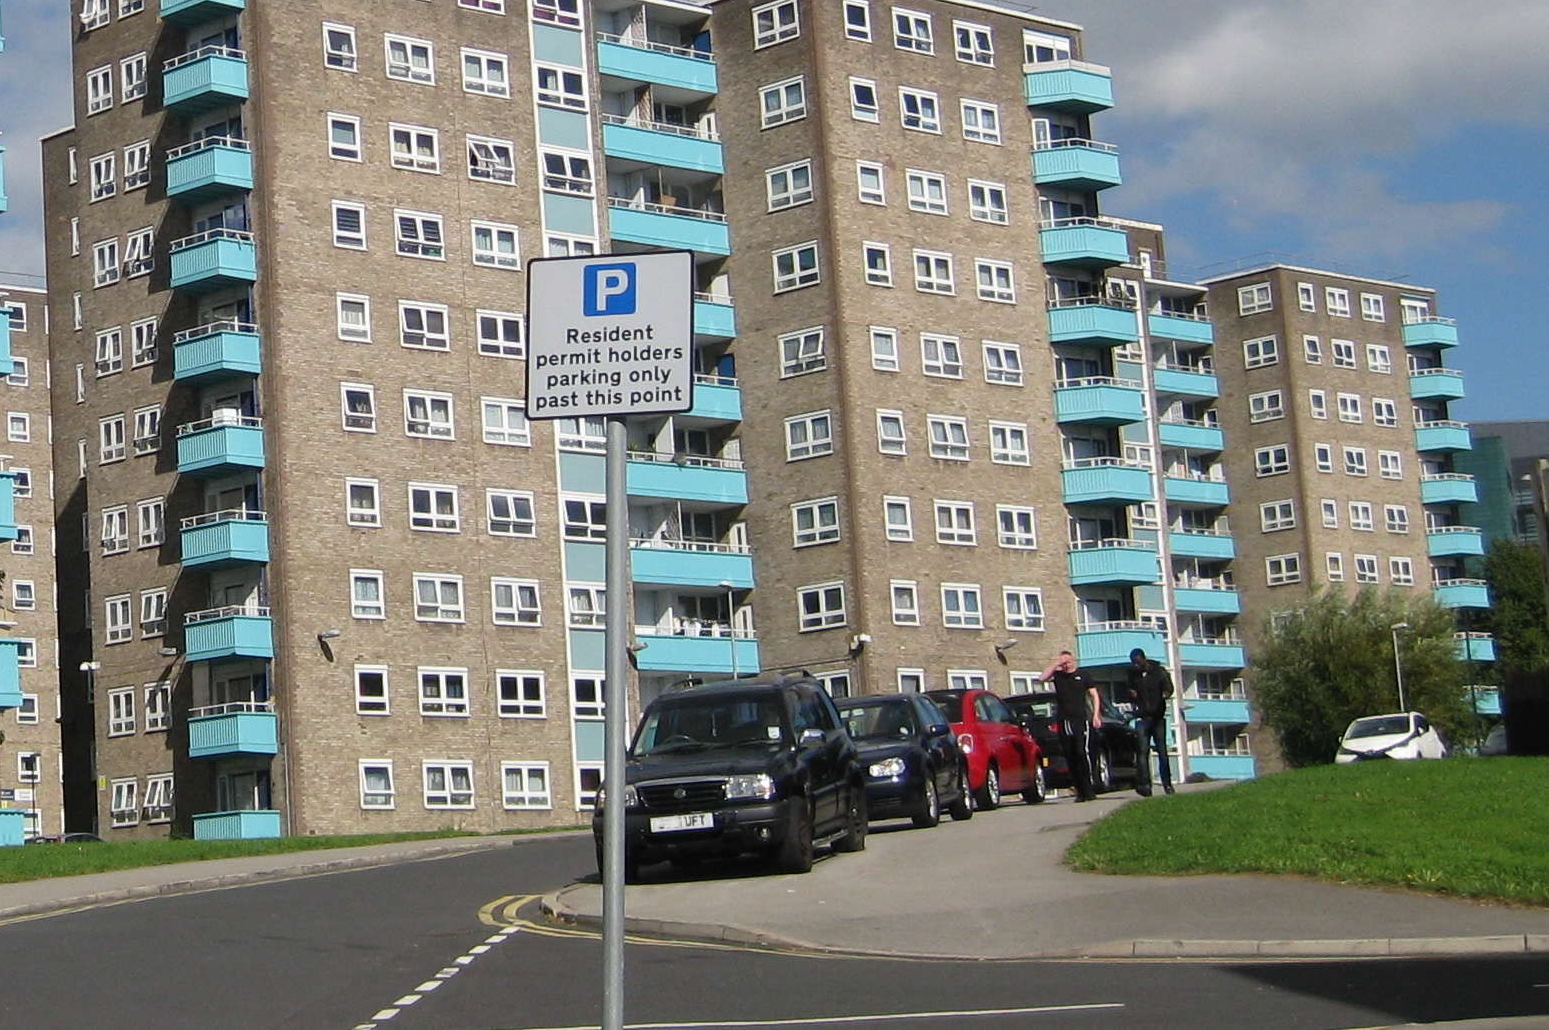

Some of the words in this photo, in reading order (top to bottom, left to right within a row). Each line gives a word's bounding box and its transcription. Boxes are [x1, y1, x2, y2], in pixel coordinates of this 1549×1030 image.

[596, 269, 629, 311] P
[566, 324, 654, 345] Resident
[536, 348, 601, 370] permit
[608, 344, 683, 363] holders
[547, 368, 622, 390] parking
[628, 365, 672, 385] only
[536, 390, 579, 412] past
[585, 387, 623, 406] this
[630, 385, 683, 407] point
[684, 815, 706, 827] UFT
